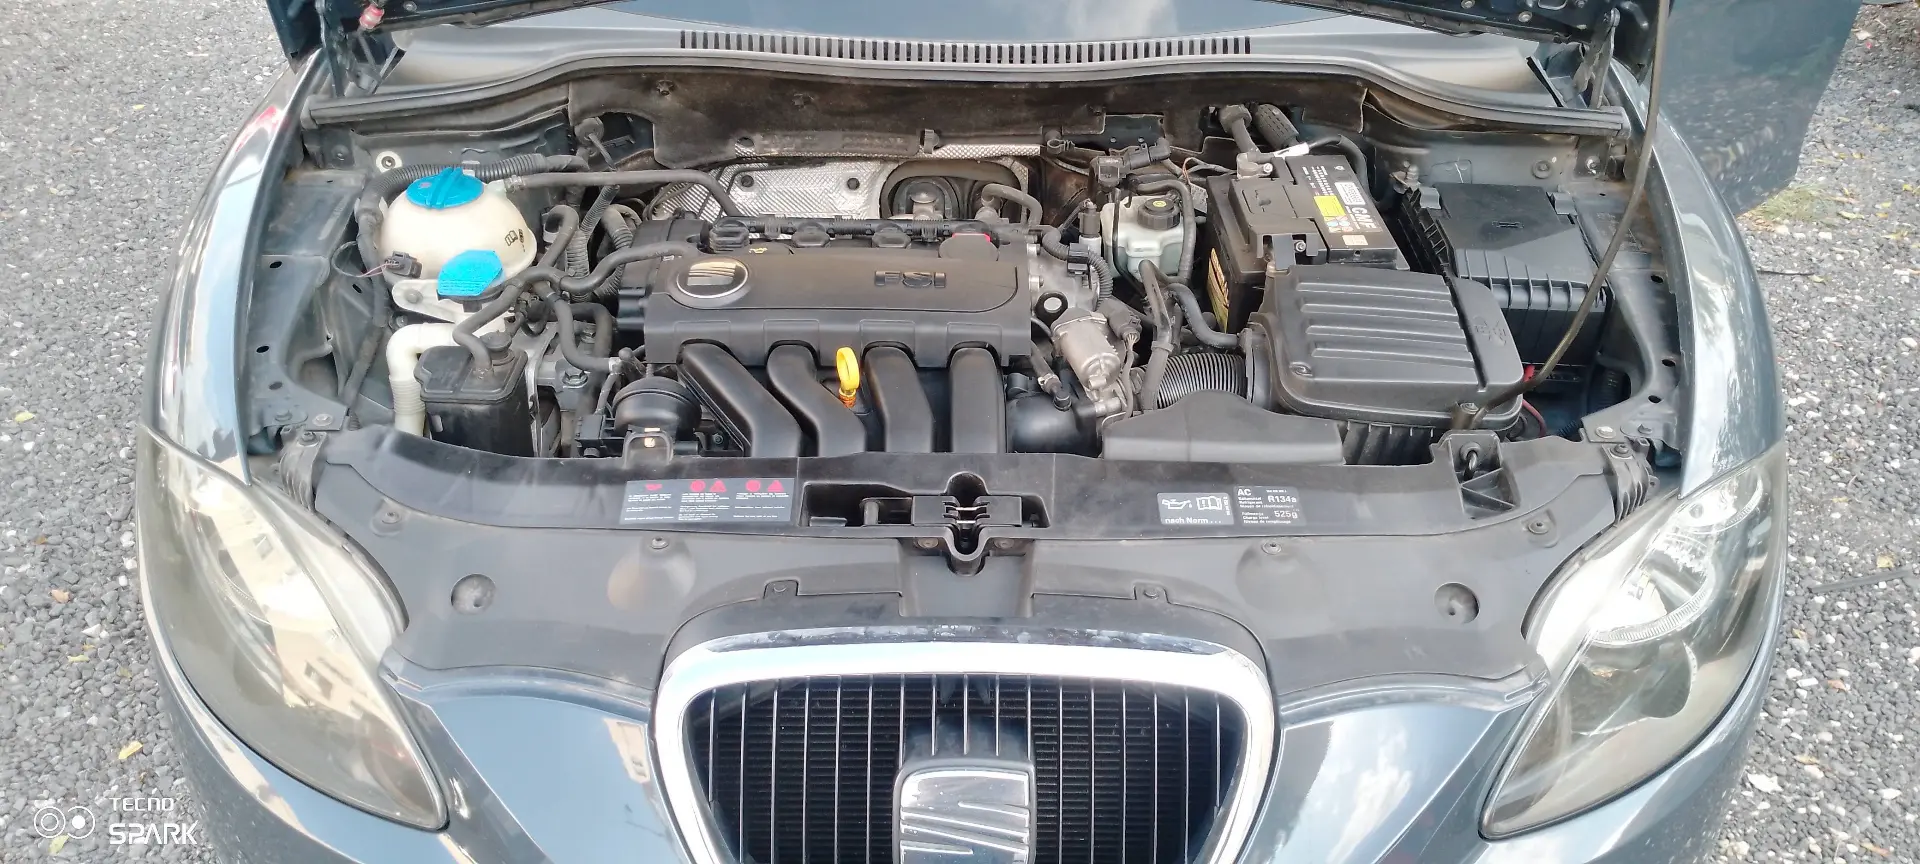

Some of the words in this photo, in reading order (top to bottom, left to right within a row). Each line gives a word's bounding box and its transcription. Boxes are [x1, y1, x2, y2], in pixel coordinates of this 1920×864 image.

[875, 270, 946, 288] FSI
[1237, 488, 1252, 496] AC
[1267, 495, 1297, 503] R134a
[1186, 516, 1209, 524] Norm
